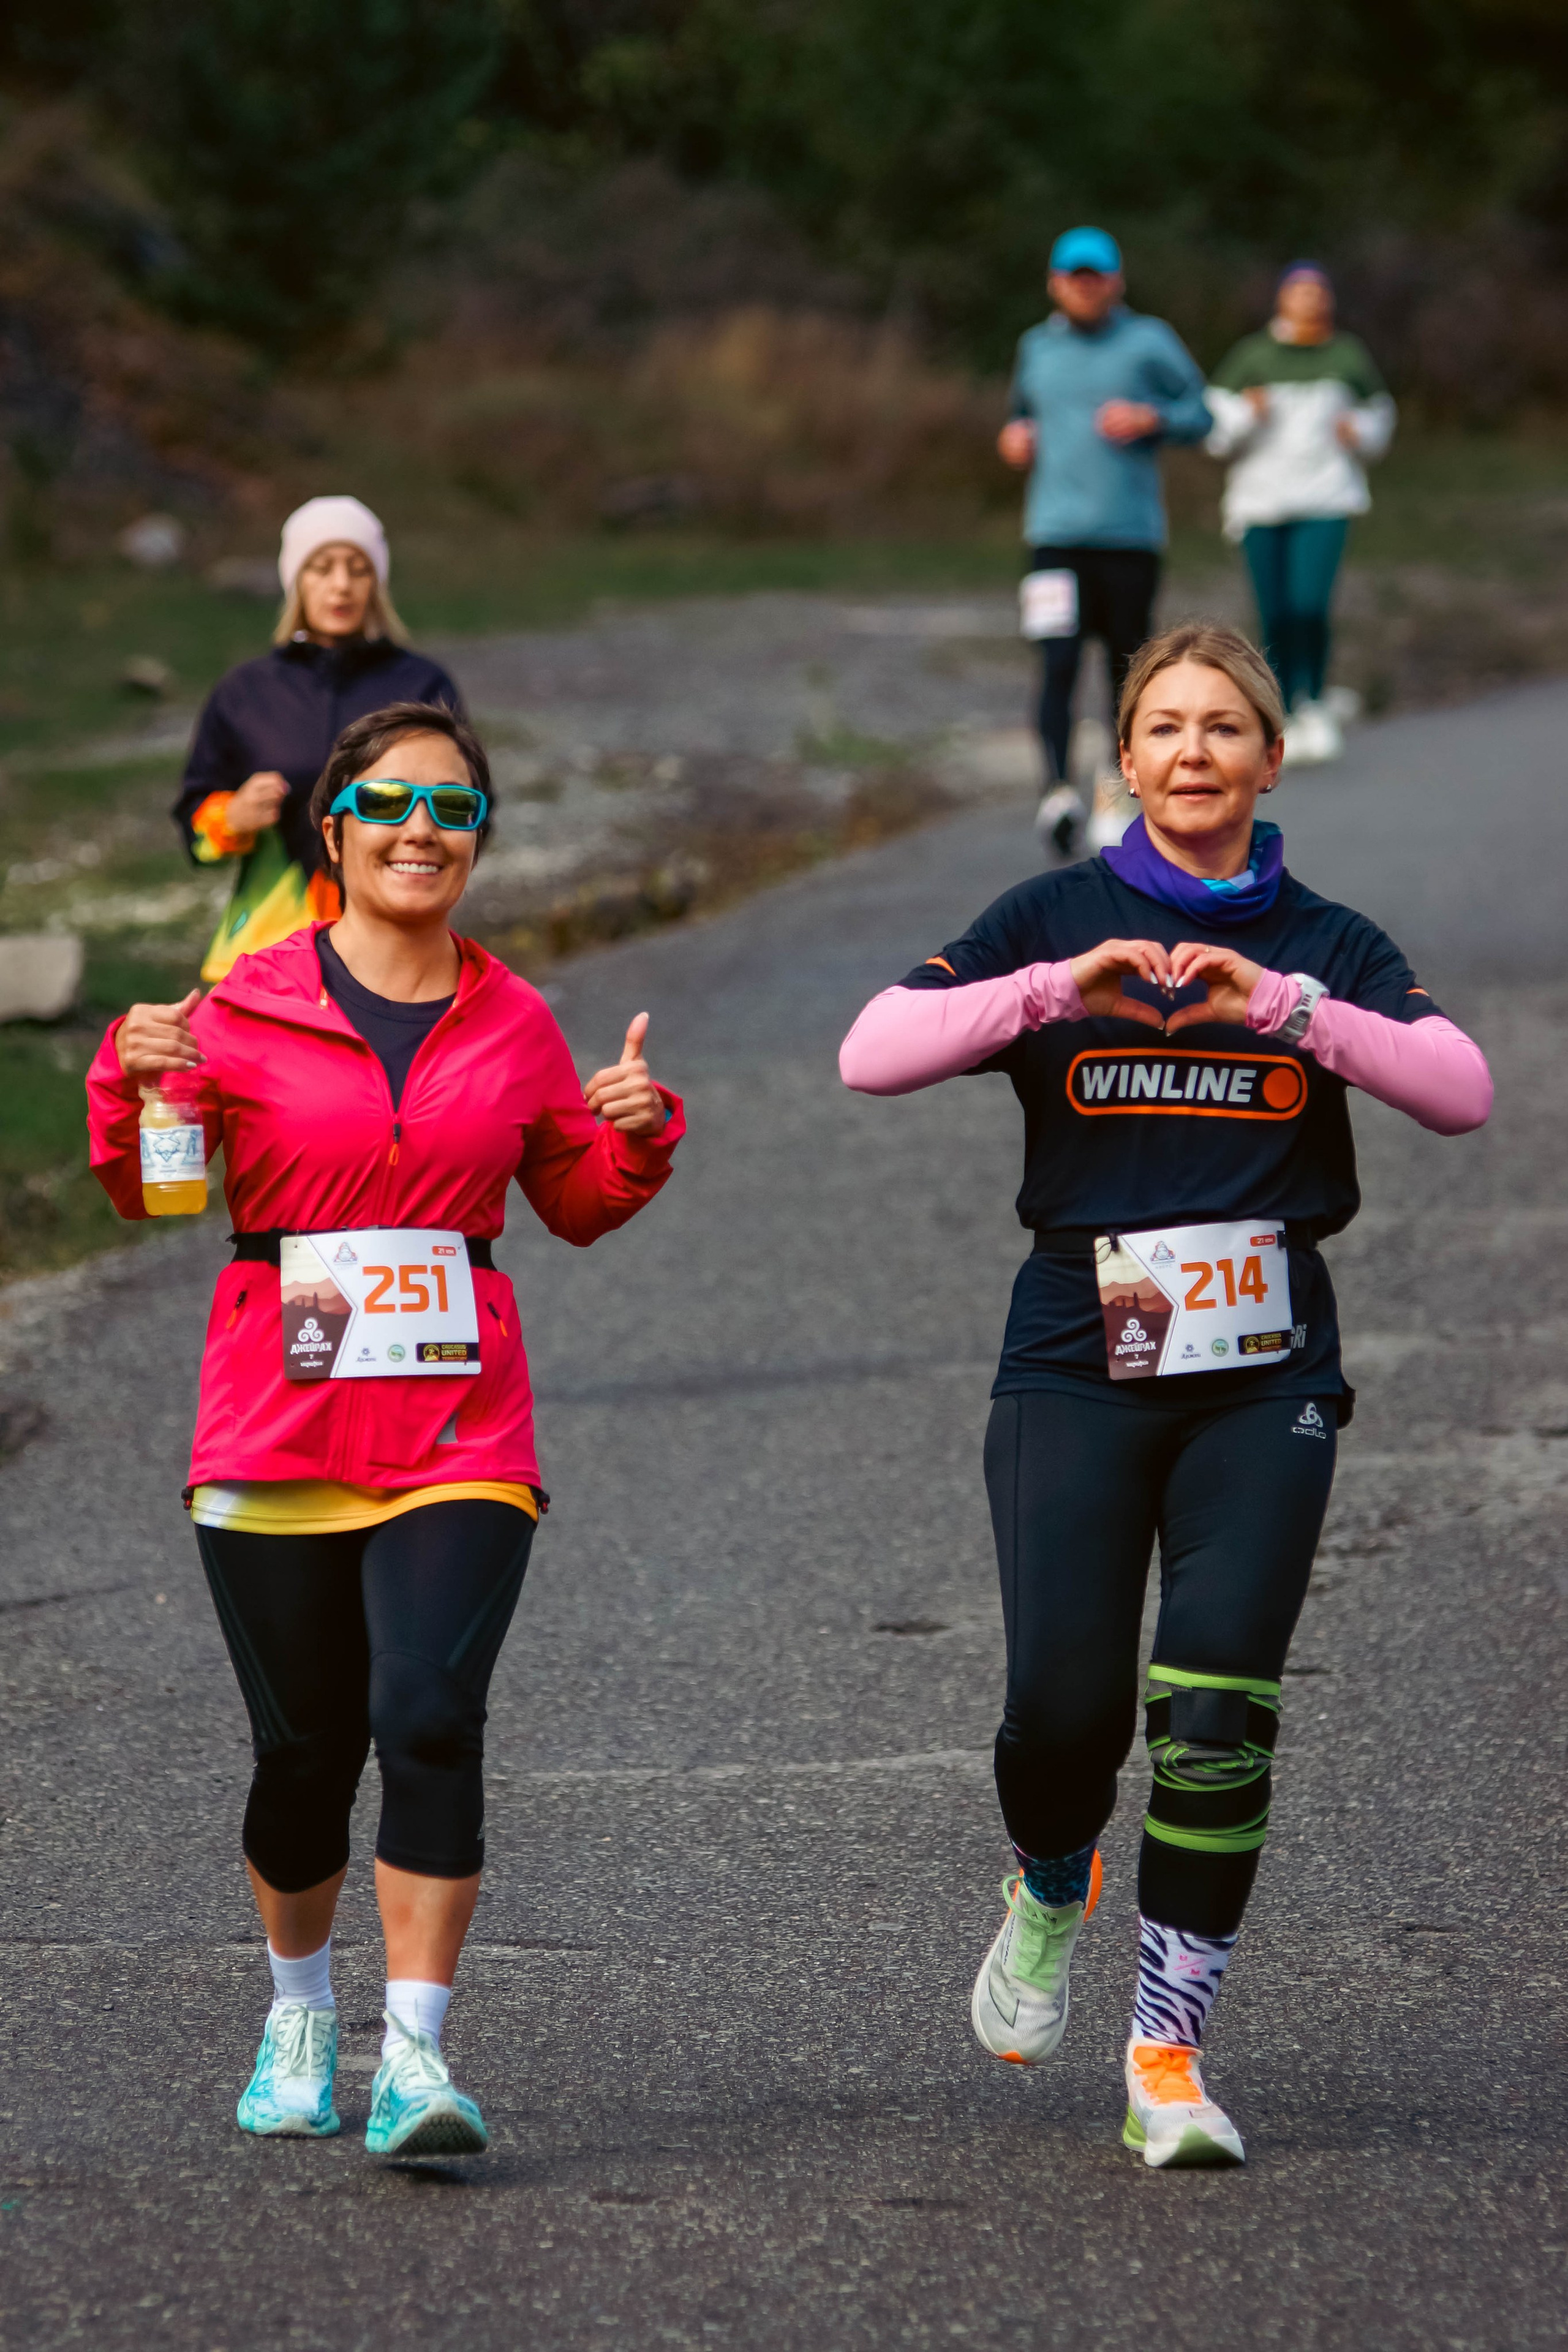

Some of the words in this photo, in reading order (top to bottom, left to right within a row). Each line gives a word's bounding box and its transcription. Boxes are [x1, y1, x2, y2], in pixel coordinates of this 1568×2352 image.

[1082, 1065, 1257, 1102] WINLINE
[363, 1265, 448, 1313] 251
[1181, 1256, 1268, 1311] 214
